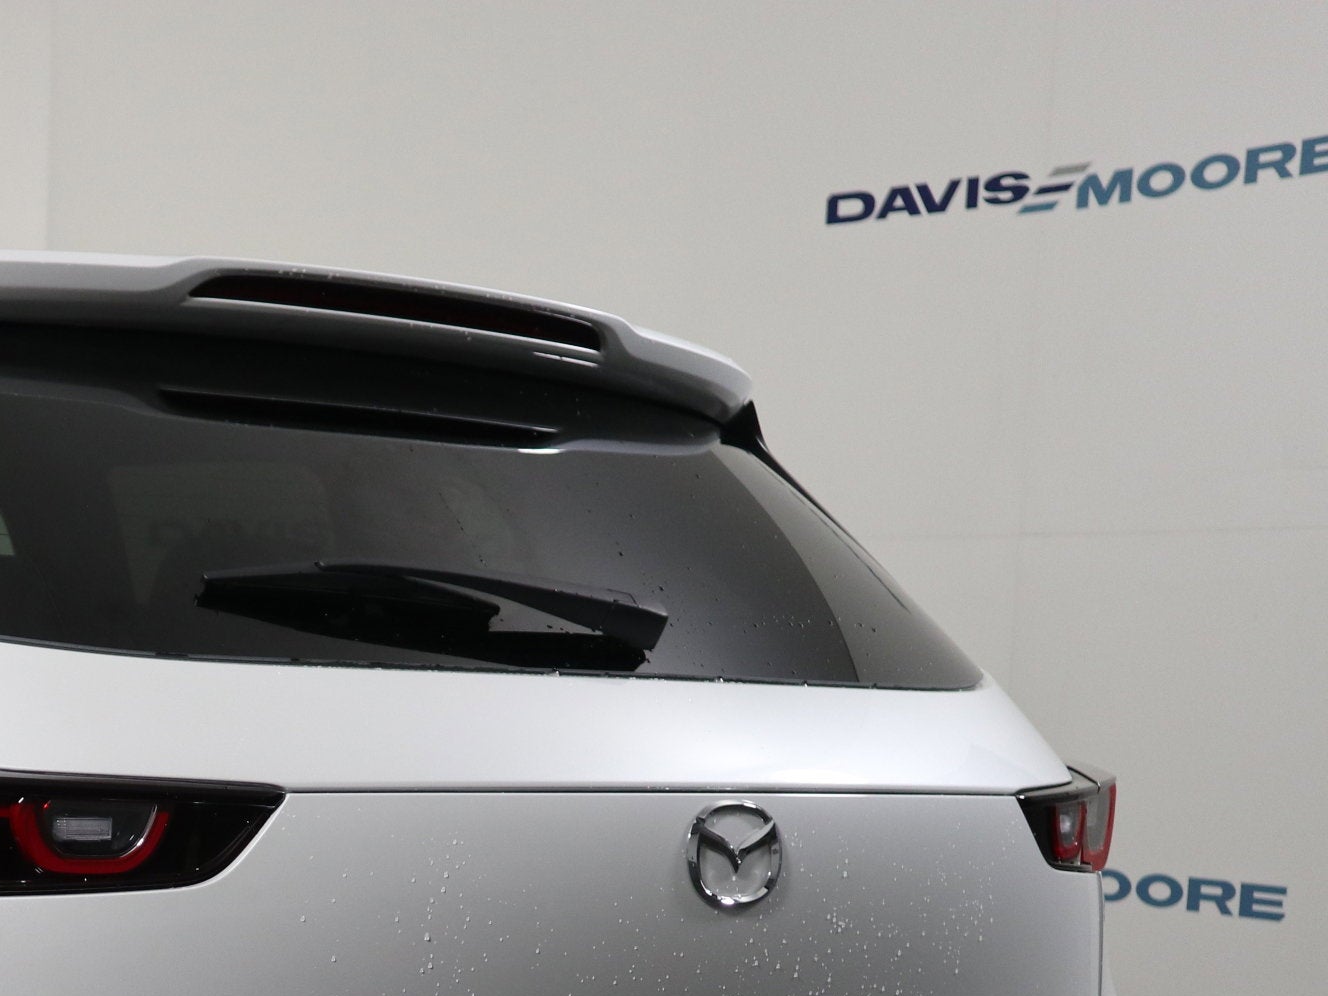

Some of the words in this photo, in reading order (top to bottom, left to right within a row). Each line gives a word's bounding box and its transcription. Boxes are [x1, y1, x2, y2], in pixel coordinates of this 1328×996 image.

[825, 171, 1031, 225] DAVIS
[1075, 135, 1328, 210] MOORE
[1101, 868, 1288, 923] OORE
